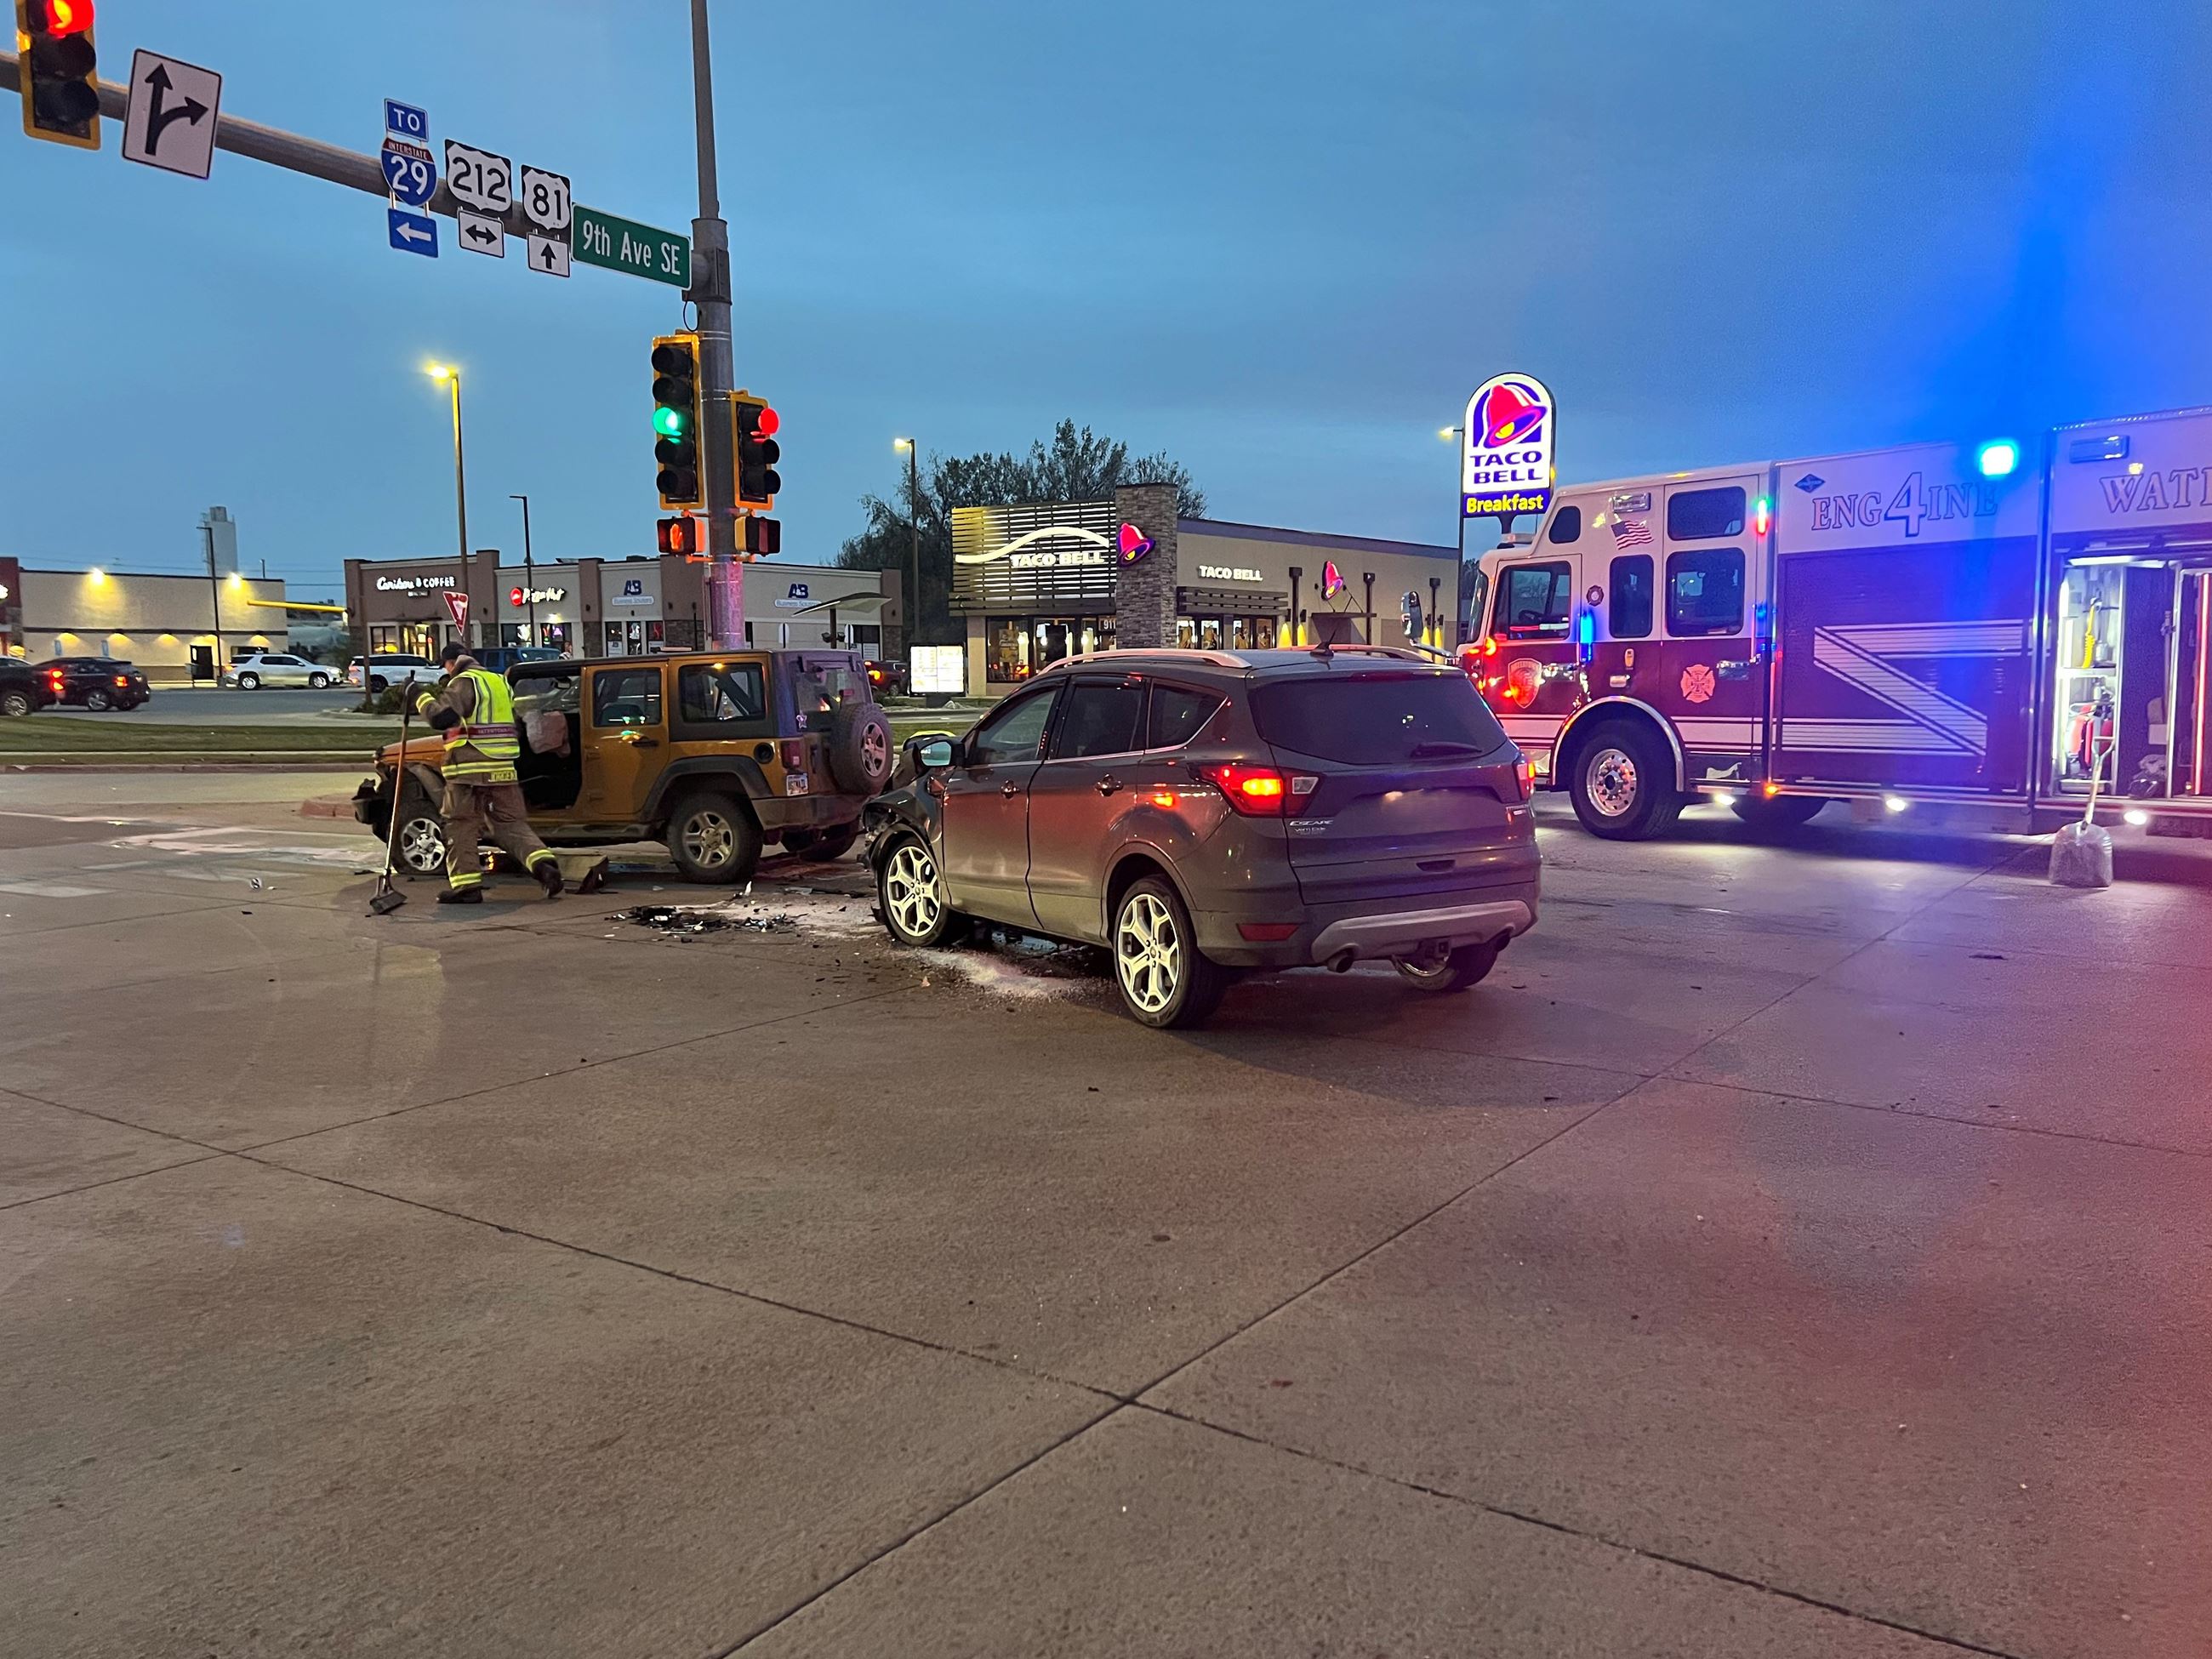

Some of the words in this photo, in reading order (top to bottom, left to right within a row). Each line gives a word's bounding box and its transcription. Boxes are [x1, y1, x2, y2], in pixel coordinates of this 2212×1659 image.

[393, 107, 420, 132] TO
[388, 141, 428, 161] INTERSTATE
[391, 155, 428, 196] 29
[452, 156, 508, 203] 212
[533, 182, 562, 221] 81
[583, 219, 611, 257] 9th
[620, 231, 652, 268] Ave
[661, 241, 681, 276] SE
[1469, 450, 1542, 468] TACO
[1474, 468, 1543, 484] BELL
[1466, 493, 1544, 514] Breakfast
[1009, 552, 1056, 567] TACO
[1058, 551, 1105, 566] BELL
[423, 576, 455, 589] COFFEE
[1199, 565, 1232, 579] TACO
[1233, 568, 1263, 582] BELL
